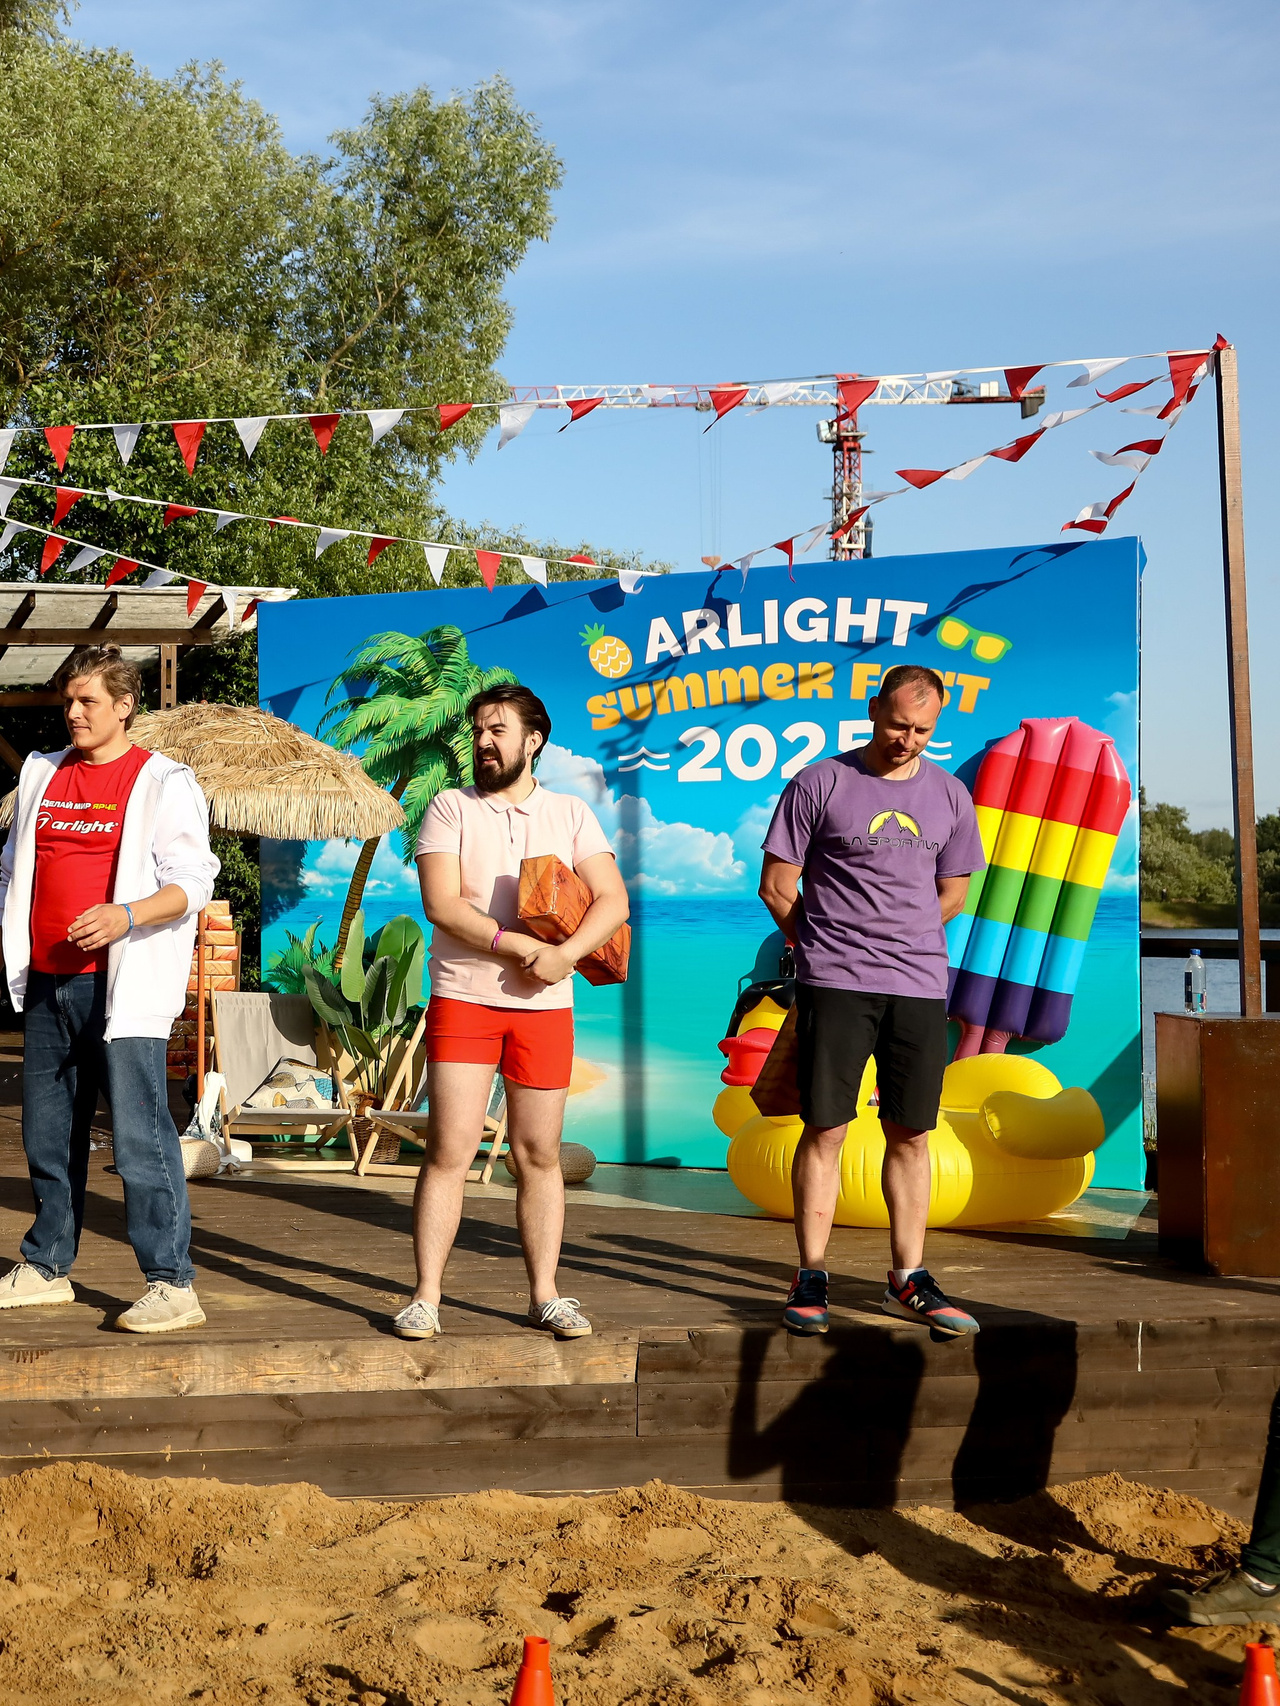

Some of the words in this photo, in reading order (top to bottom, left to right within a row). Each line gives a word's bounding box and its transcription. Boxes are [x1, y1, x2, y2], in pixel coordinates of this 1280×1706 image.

[645, 597, 929, 664] ARLIGHT
[850, 662, 991, 714] FT
[41, 799, 73, 810] ДЕЛАЙ
[73, 802, 92, 810] МИР
[92, 803, 118, 811] ЯРЧЕ
[51, 820, 116, 834] arlight
[842, 836, 862, 846] LA
[867, 836, 940, 852] SPORTIVA
